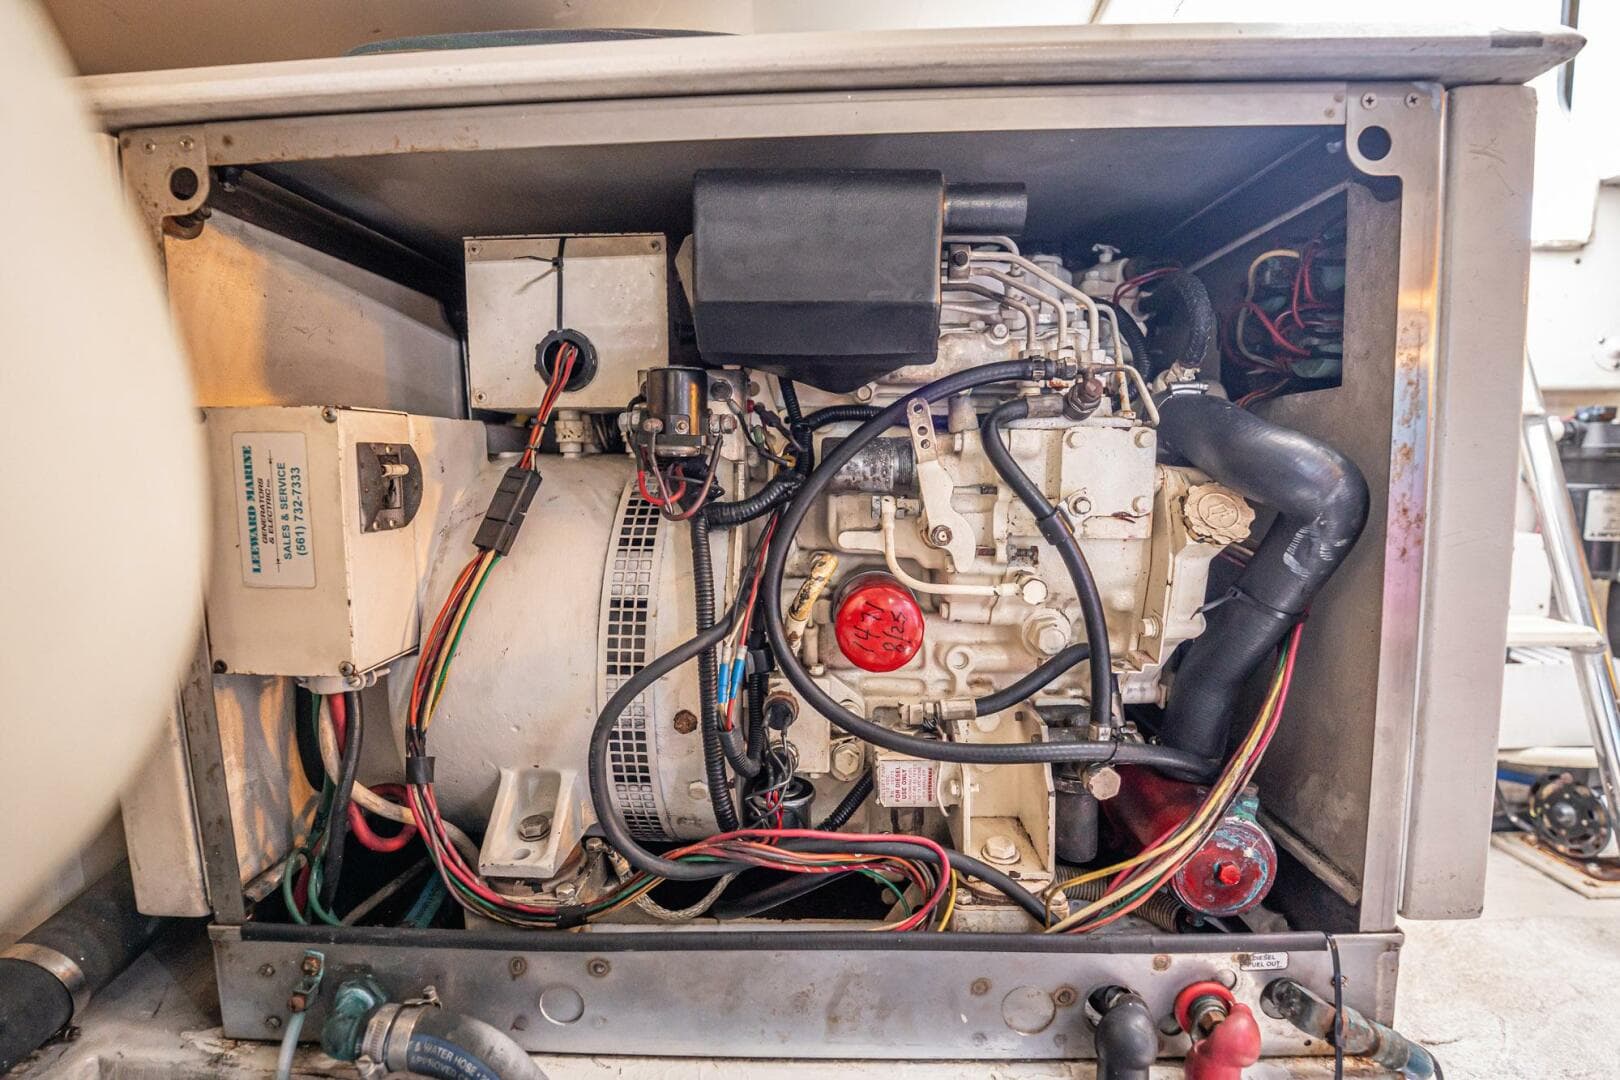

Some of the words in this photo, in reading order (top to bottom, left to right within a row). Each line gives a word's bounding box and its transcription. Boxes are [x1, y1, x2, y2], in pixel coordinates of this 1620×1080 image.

[242, 446, 255, 501] MARINE
[276, 463, 288, 510] SERVICE
[291, 467, 303, 522] 732-7333
[257, 477, 267, 544] GENERATORS
[265, 489, 274, 534] ELECTRIC
[247, 506, 261, 573] LEEWARD
[280, 525, 292, 560] SALES
[295, 526, 308, 556] (561)
[423, 1041, 454, 1062] WATER
[454, 1055, 478, 1075] HOSE
